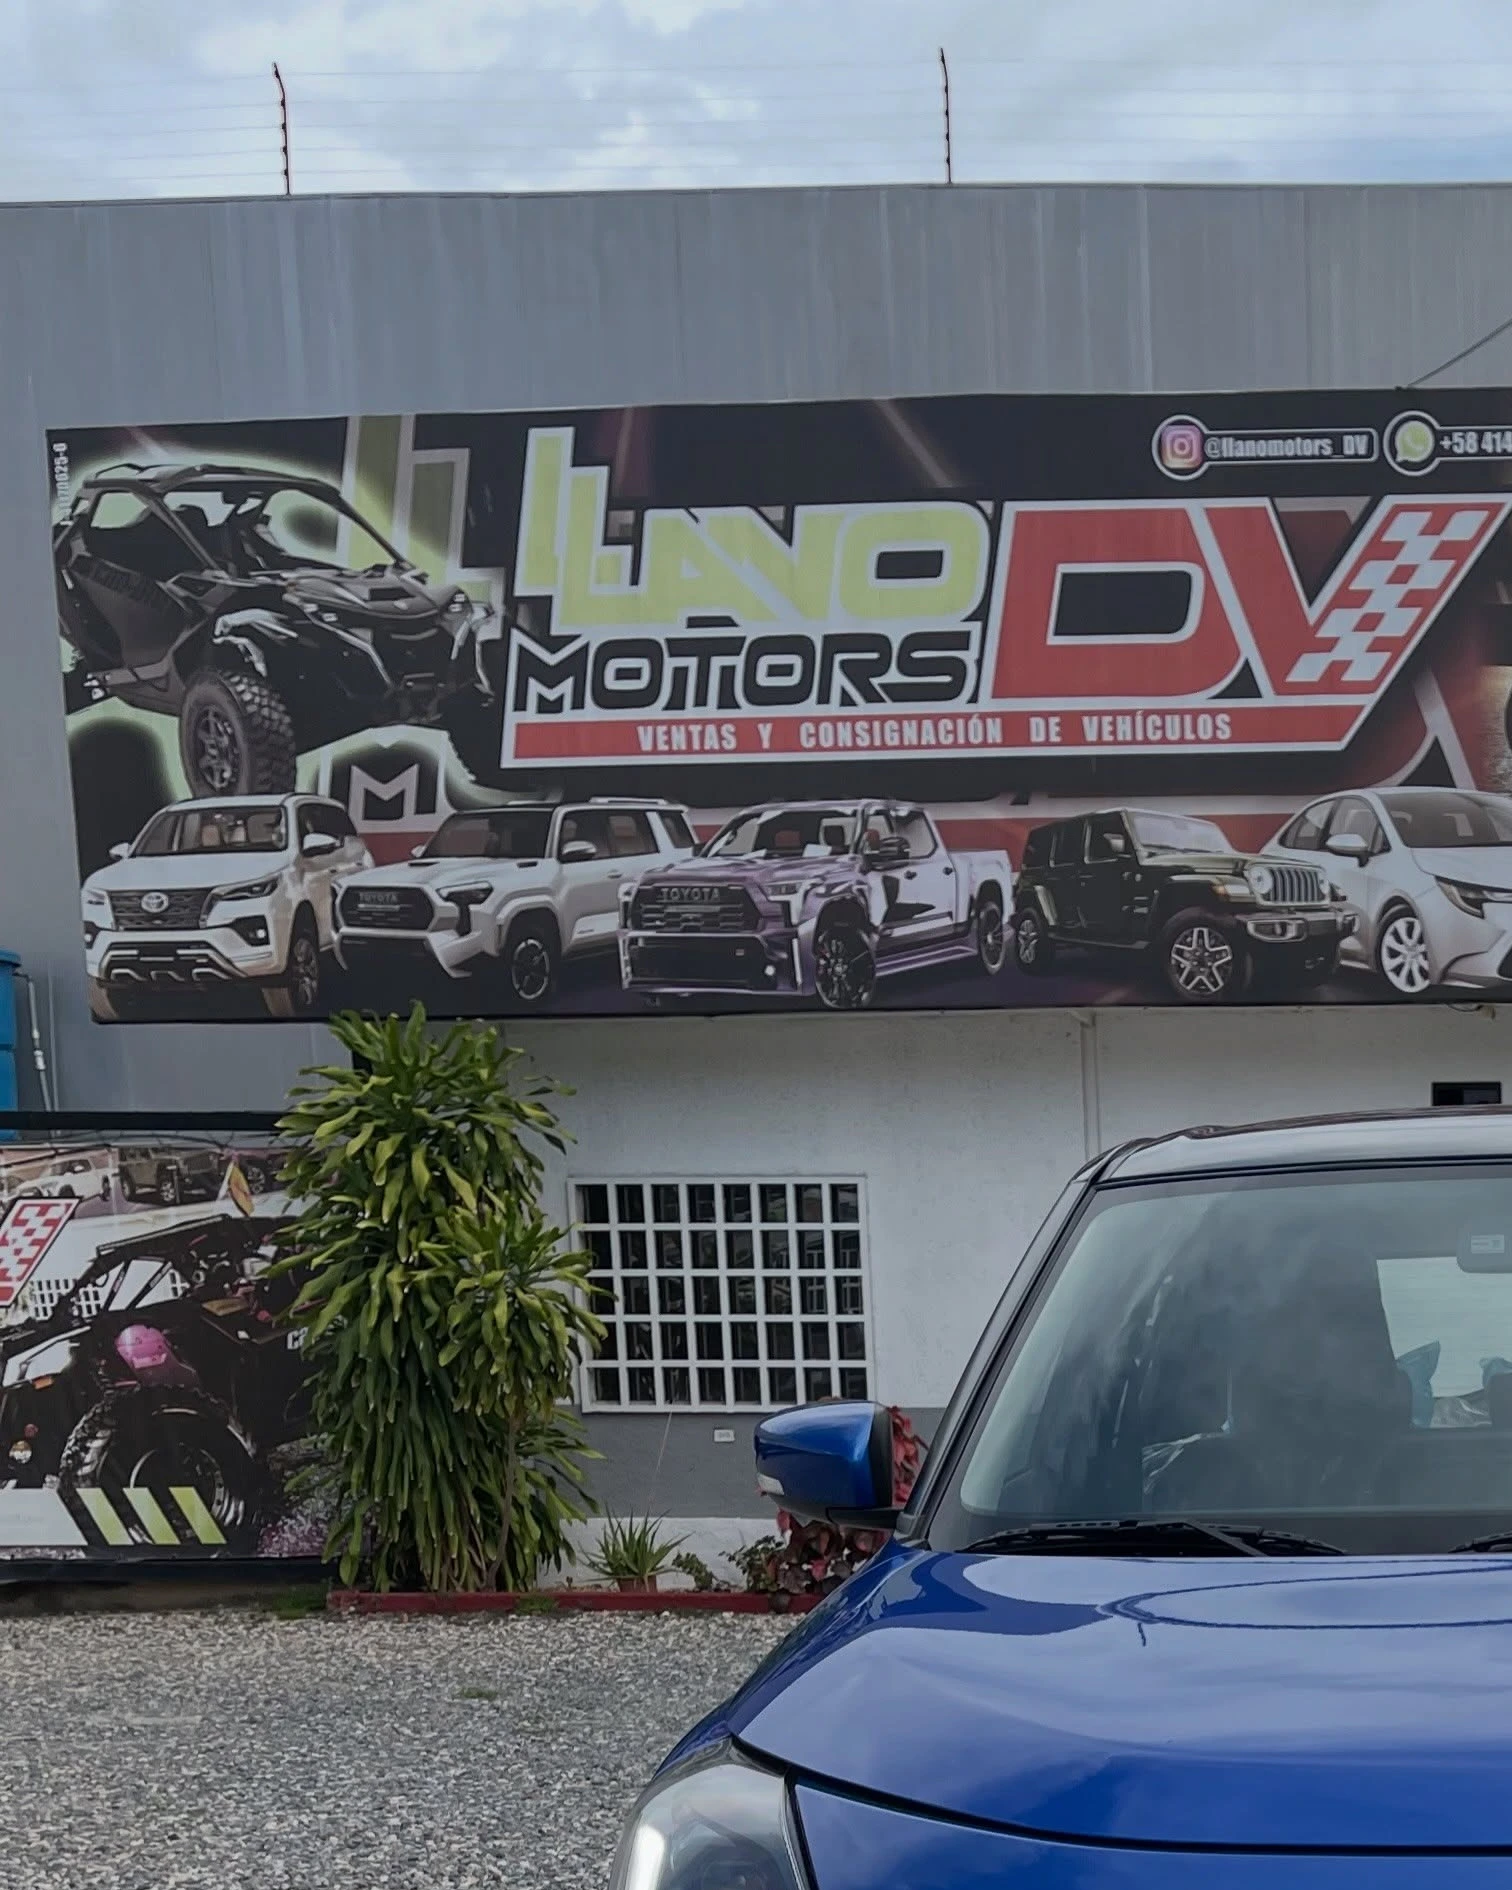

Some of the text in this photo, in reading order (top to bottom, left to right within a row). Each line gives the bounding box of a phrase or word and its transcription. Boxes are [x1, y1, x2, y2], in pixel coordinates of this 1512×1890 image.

[1439, 431, 1479, 454] +58
[515, 428, 992, 634] LLANO
[511, 631, 976, 713] MOTORS
[637, 711, 1232, 751] VENTAS Y CONSIGNACIÓN DE VEHÍCULOS
[660, 887, 720, 900] TOYOTA
